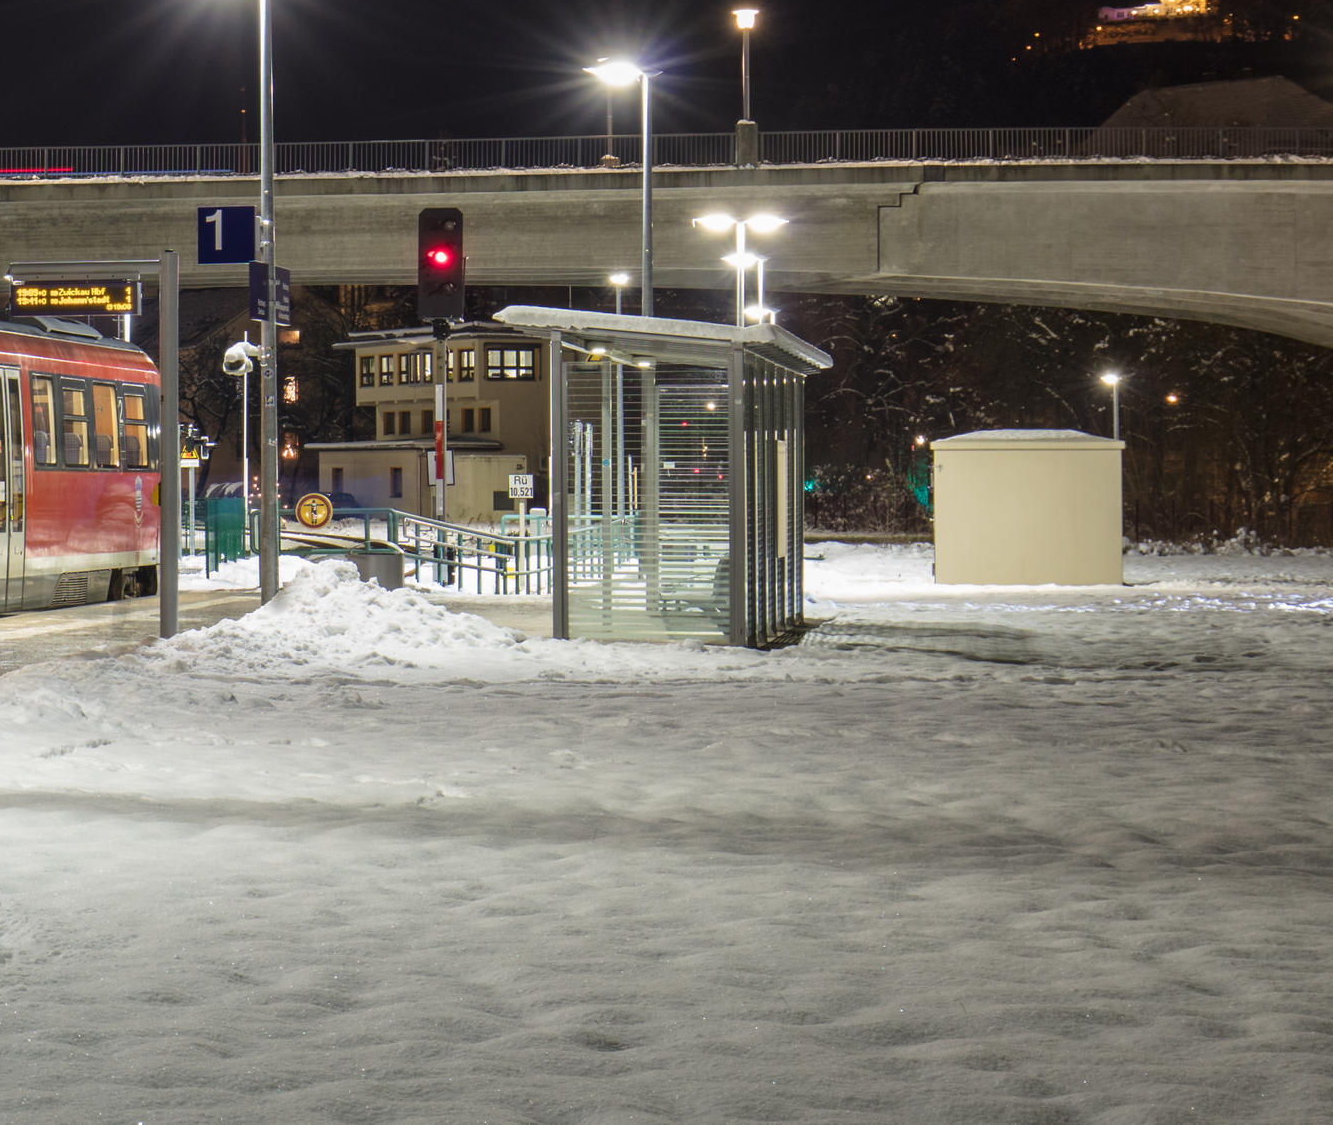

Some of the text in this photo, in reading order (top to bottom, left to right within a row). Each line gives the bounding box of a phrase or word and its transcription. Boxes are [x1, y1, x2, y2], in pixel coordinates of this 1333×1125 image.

[205, 209, 223, 251] 1
[125, 286, 132, 295] 1
[125, 295, 132, 303] 1
[514, 475, 528, 485] Rü
